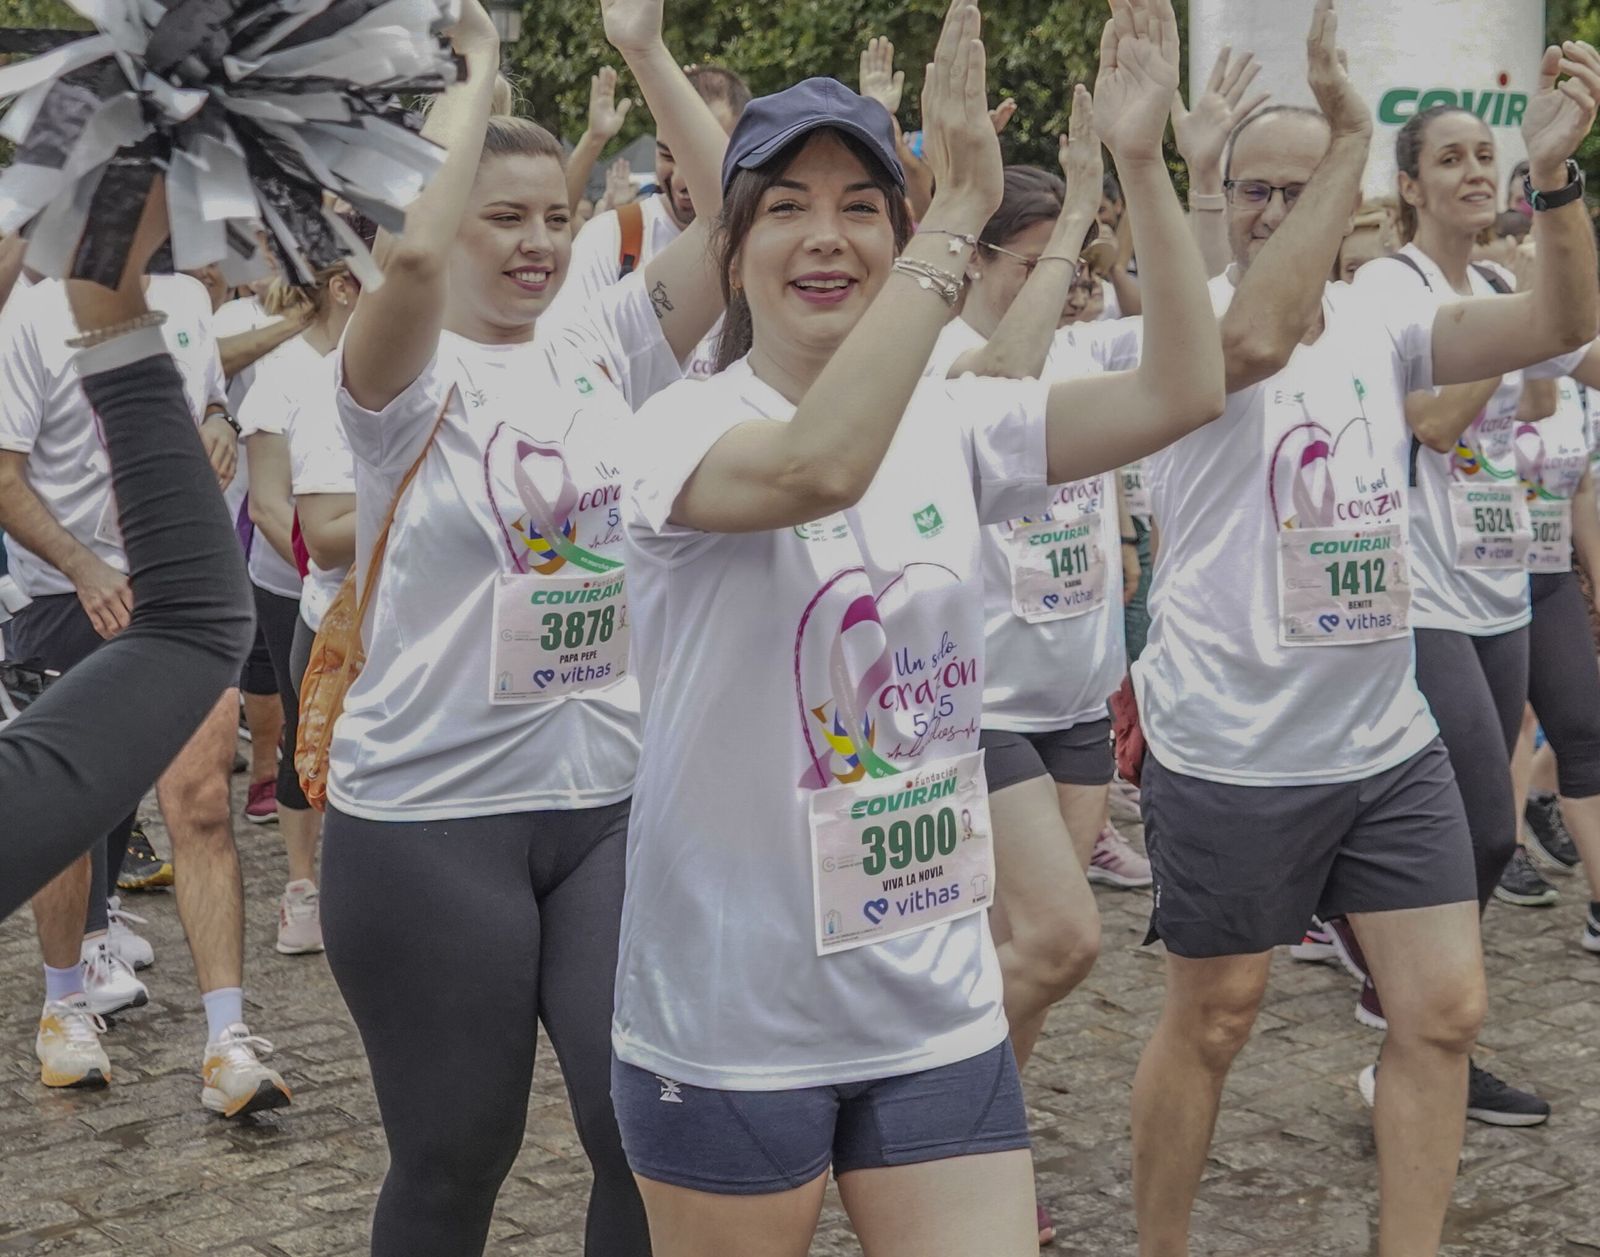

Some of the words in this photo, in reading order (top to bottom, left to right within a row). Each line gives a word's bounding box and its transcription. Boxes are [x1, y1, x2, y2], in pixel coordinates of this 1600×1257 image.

[1029, 524, 1091, 546] COVIRAN
[1310, 532, 1391, 555] COVIRAN
[1045, 543, 1089, 578] 1411
[1325, 557, 1387, 596] 1412
[530, 580, 624, 605] COVIRAN
[540, 604, 616, 651] 3878
[1346, 614, 1392, 630] vithas
[559, 653, 579, 664] PAPA
[580, 650, 598, 661] PEPE
[895, 647, 926, 676] Un
[560, 663, 612, 684] vithas
[914, 767, 958, 788] Fundación
[851, 775, 957, 820] COVIRAN
[861, 806, 957, 876] 3900
[882, 875, 905, 892] VIVA
[906, 872, 917, 885] LA
[918, 865, 945, 883] NOVIA
[895, 883, 961, 916] vithas
